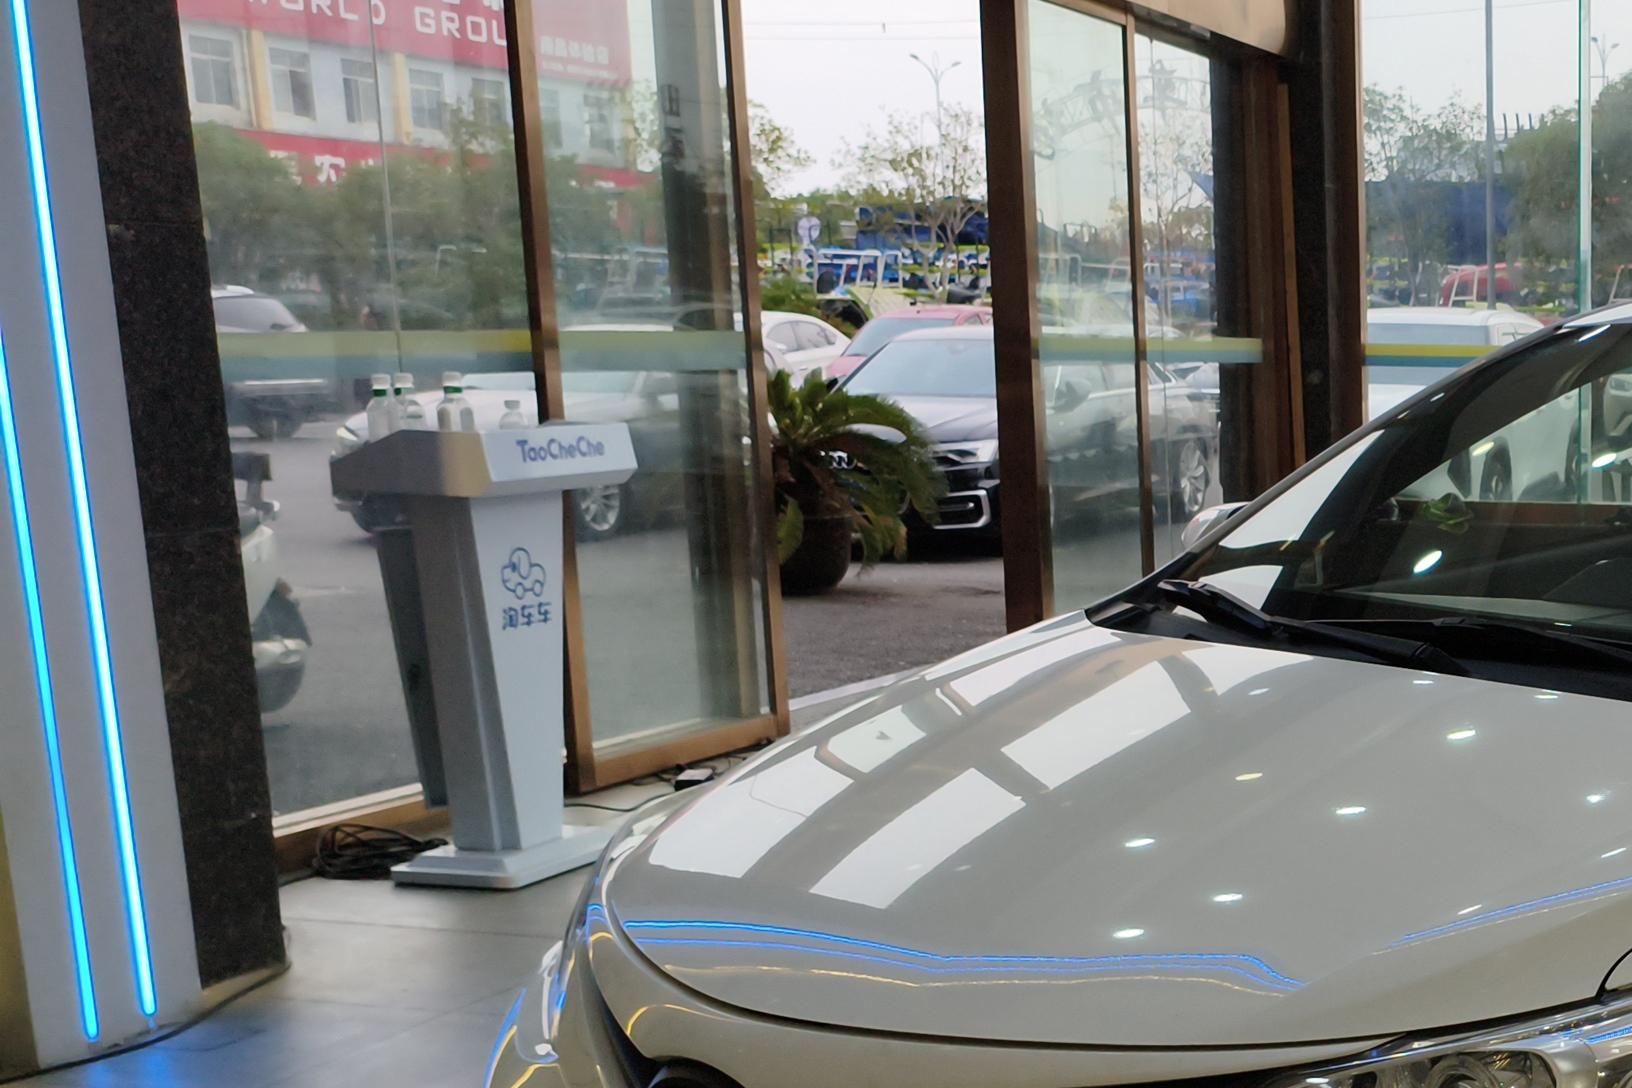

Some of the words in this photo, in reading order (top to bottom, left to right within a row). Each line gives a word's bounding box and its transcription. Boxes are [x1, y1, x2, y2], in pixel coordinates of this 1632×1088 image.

[515, 436, 605, 463] TaoCheChe
[502, 601, 552, 631] 淘车车
